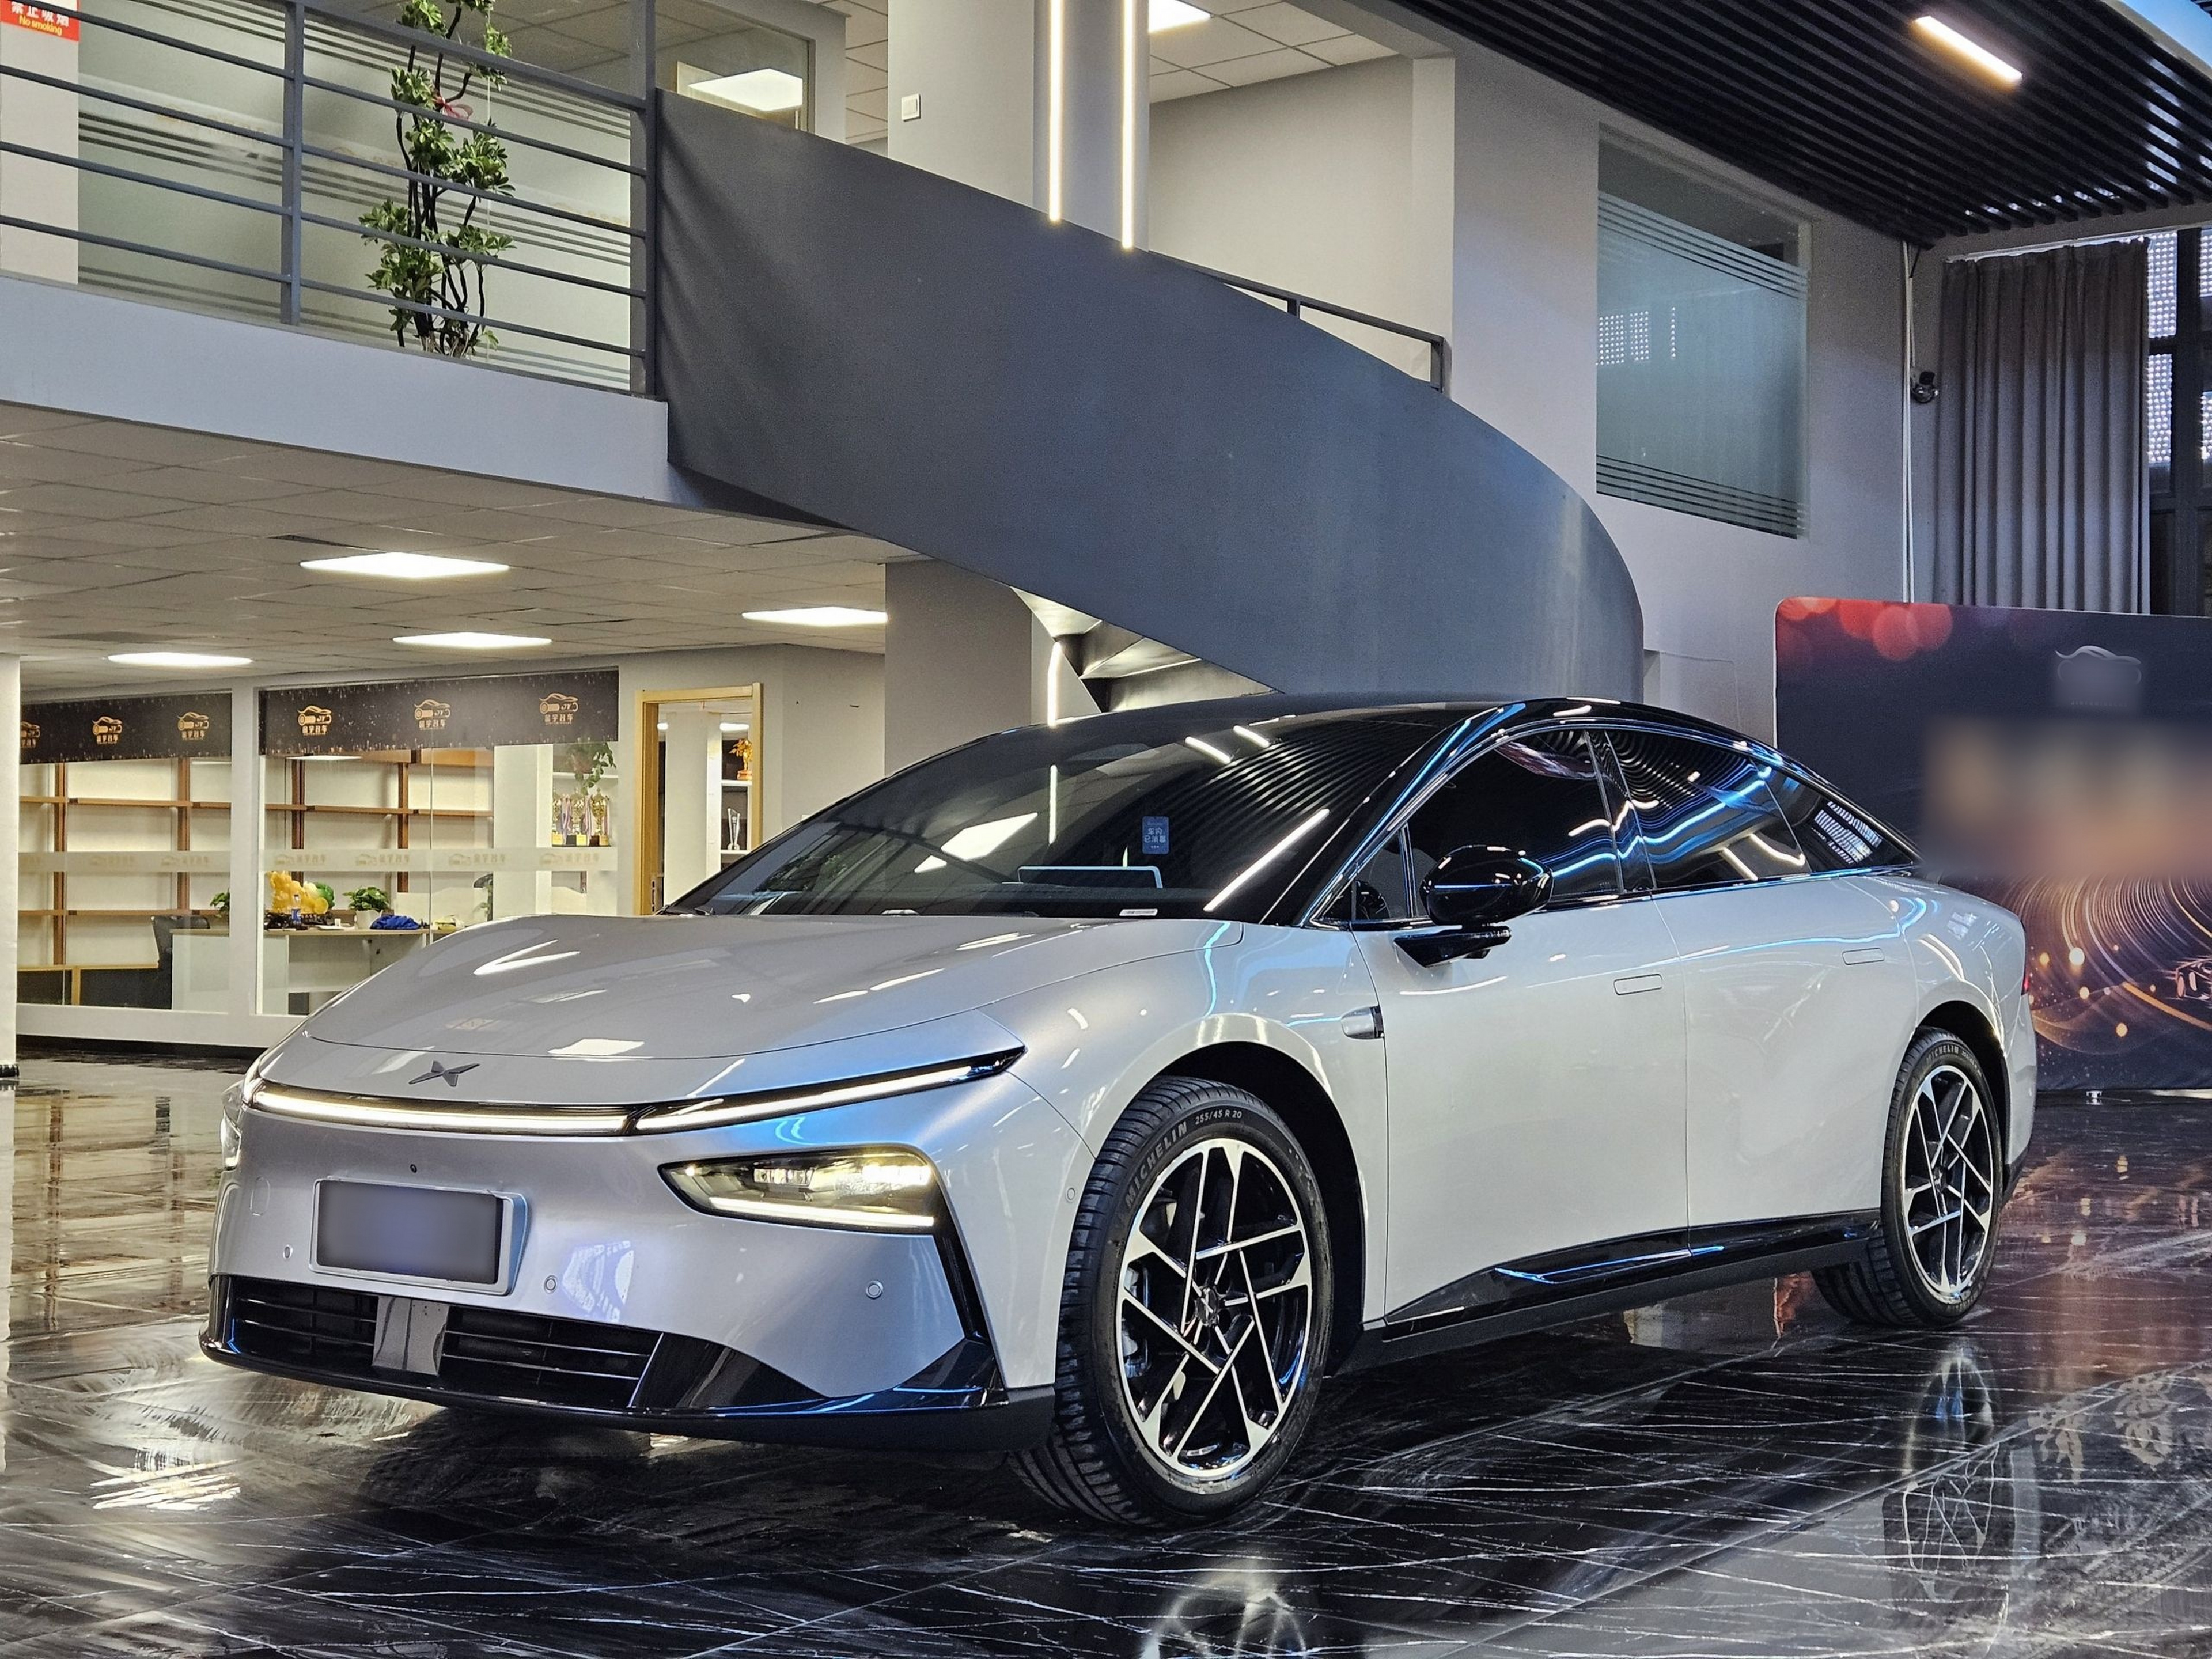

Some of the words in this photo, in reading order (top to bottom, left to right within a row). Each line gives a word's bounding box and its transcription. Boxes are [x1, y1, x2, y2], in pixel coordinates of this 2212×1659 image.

[19, 14, 31, 26] No
[31, 20, 62, 36] smoking
[1195, 1109, 1223, 1125] 255/45
[1224, 1109, 1230, 1118] R
[1232, 1109, 1243, 1119] 20
[1125, 1120, 1187, 1207] MICHELIN
